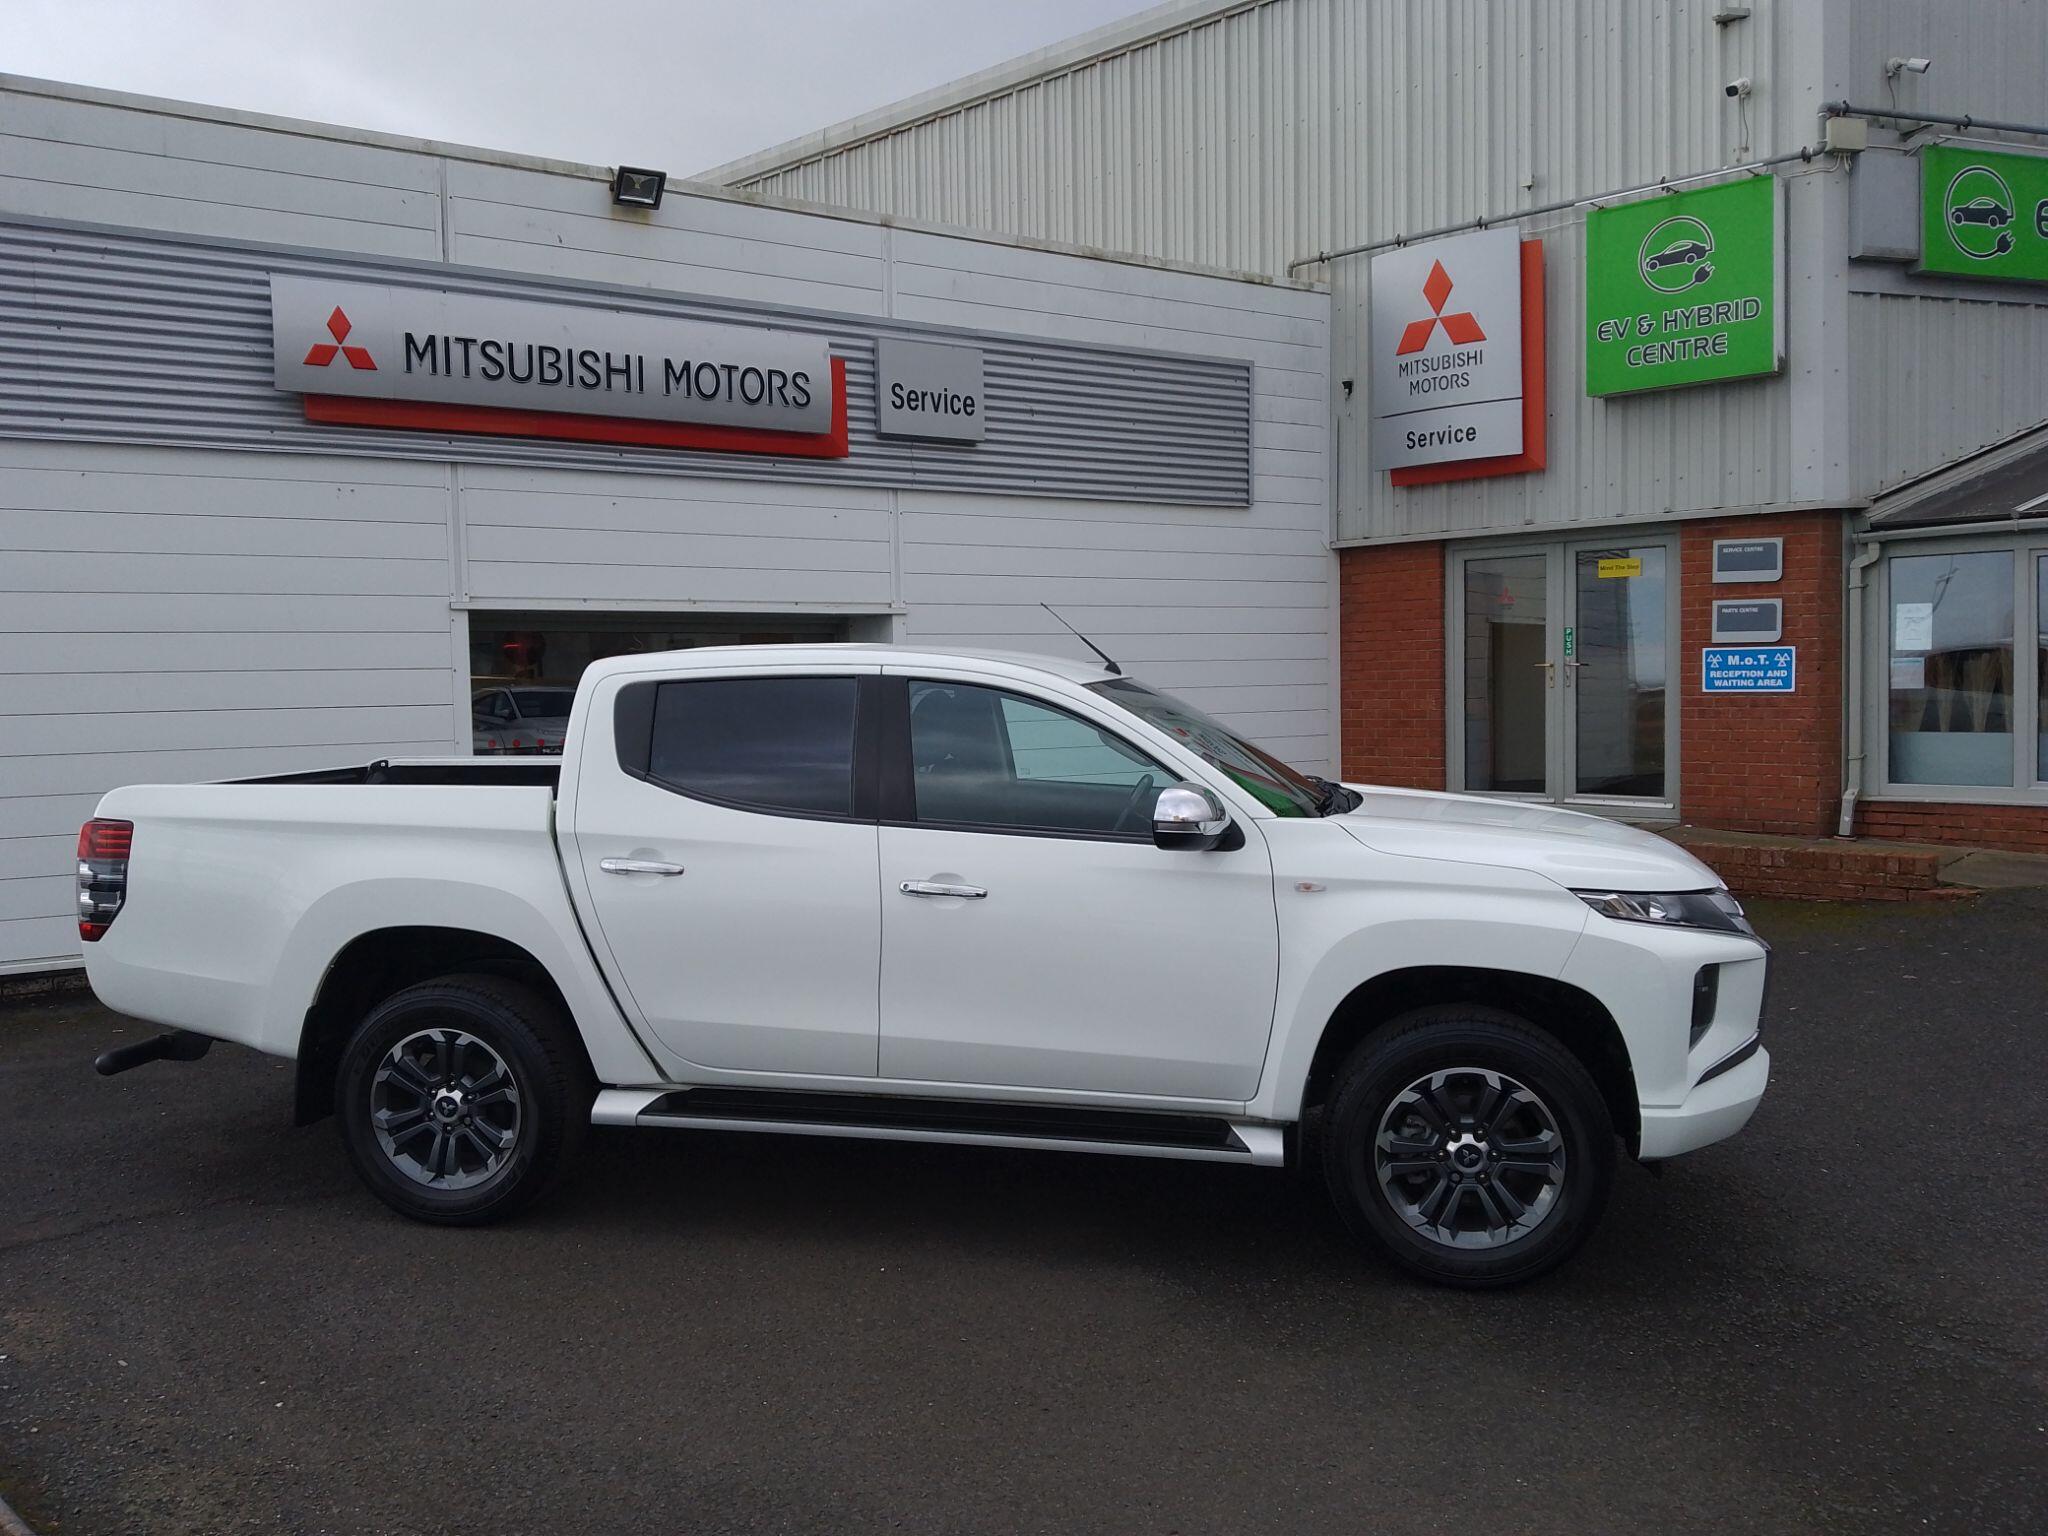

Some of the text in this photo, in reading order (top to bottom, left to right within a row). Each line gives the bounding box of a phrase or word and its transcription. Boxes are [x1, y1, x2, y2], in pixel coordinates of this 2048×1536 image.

[1597, 297, 1762, 342] EV & HYBRID
[1626, 332, 1728, 367] CENTRE
[403, 331, 811, 410] MITSUBISHI MOTORS
[1399, 349, 1483, 378] MITSUBISHI
[1409, 371, 1470, 396] MOTORS
[891, 382, 976, 416] Service
[1406, 424, 1477, 450] Service
[1727, 654, 1770, 666] M.o.T.
[1709, 670, 1764, 678] RECEPTION
[1714, 679, 1783, 687] WAITING AREA
